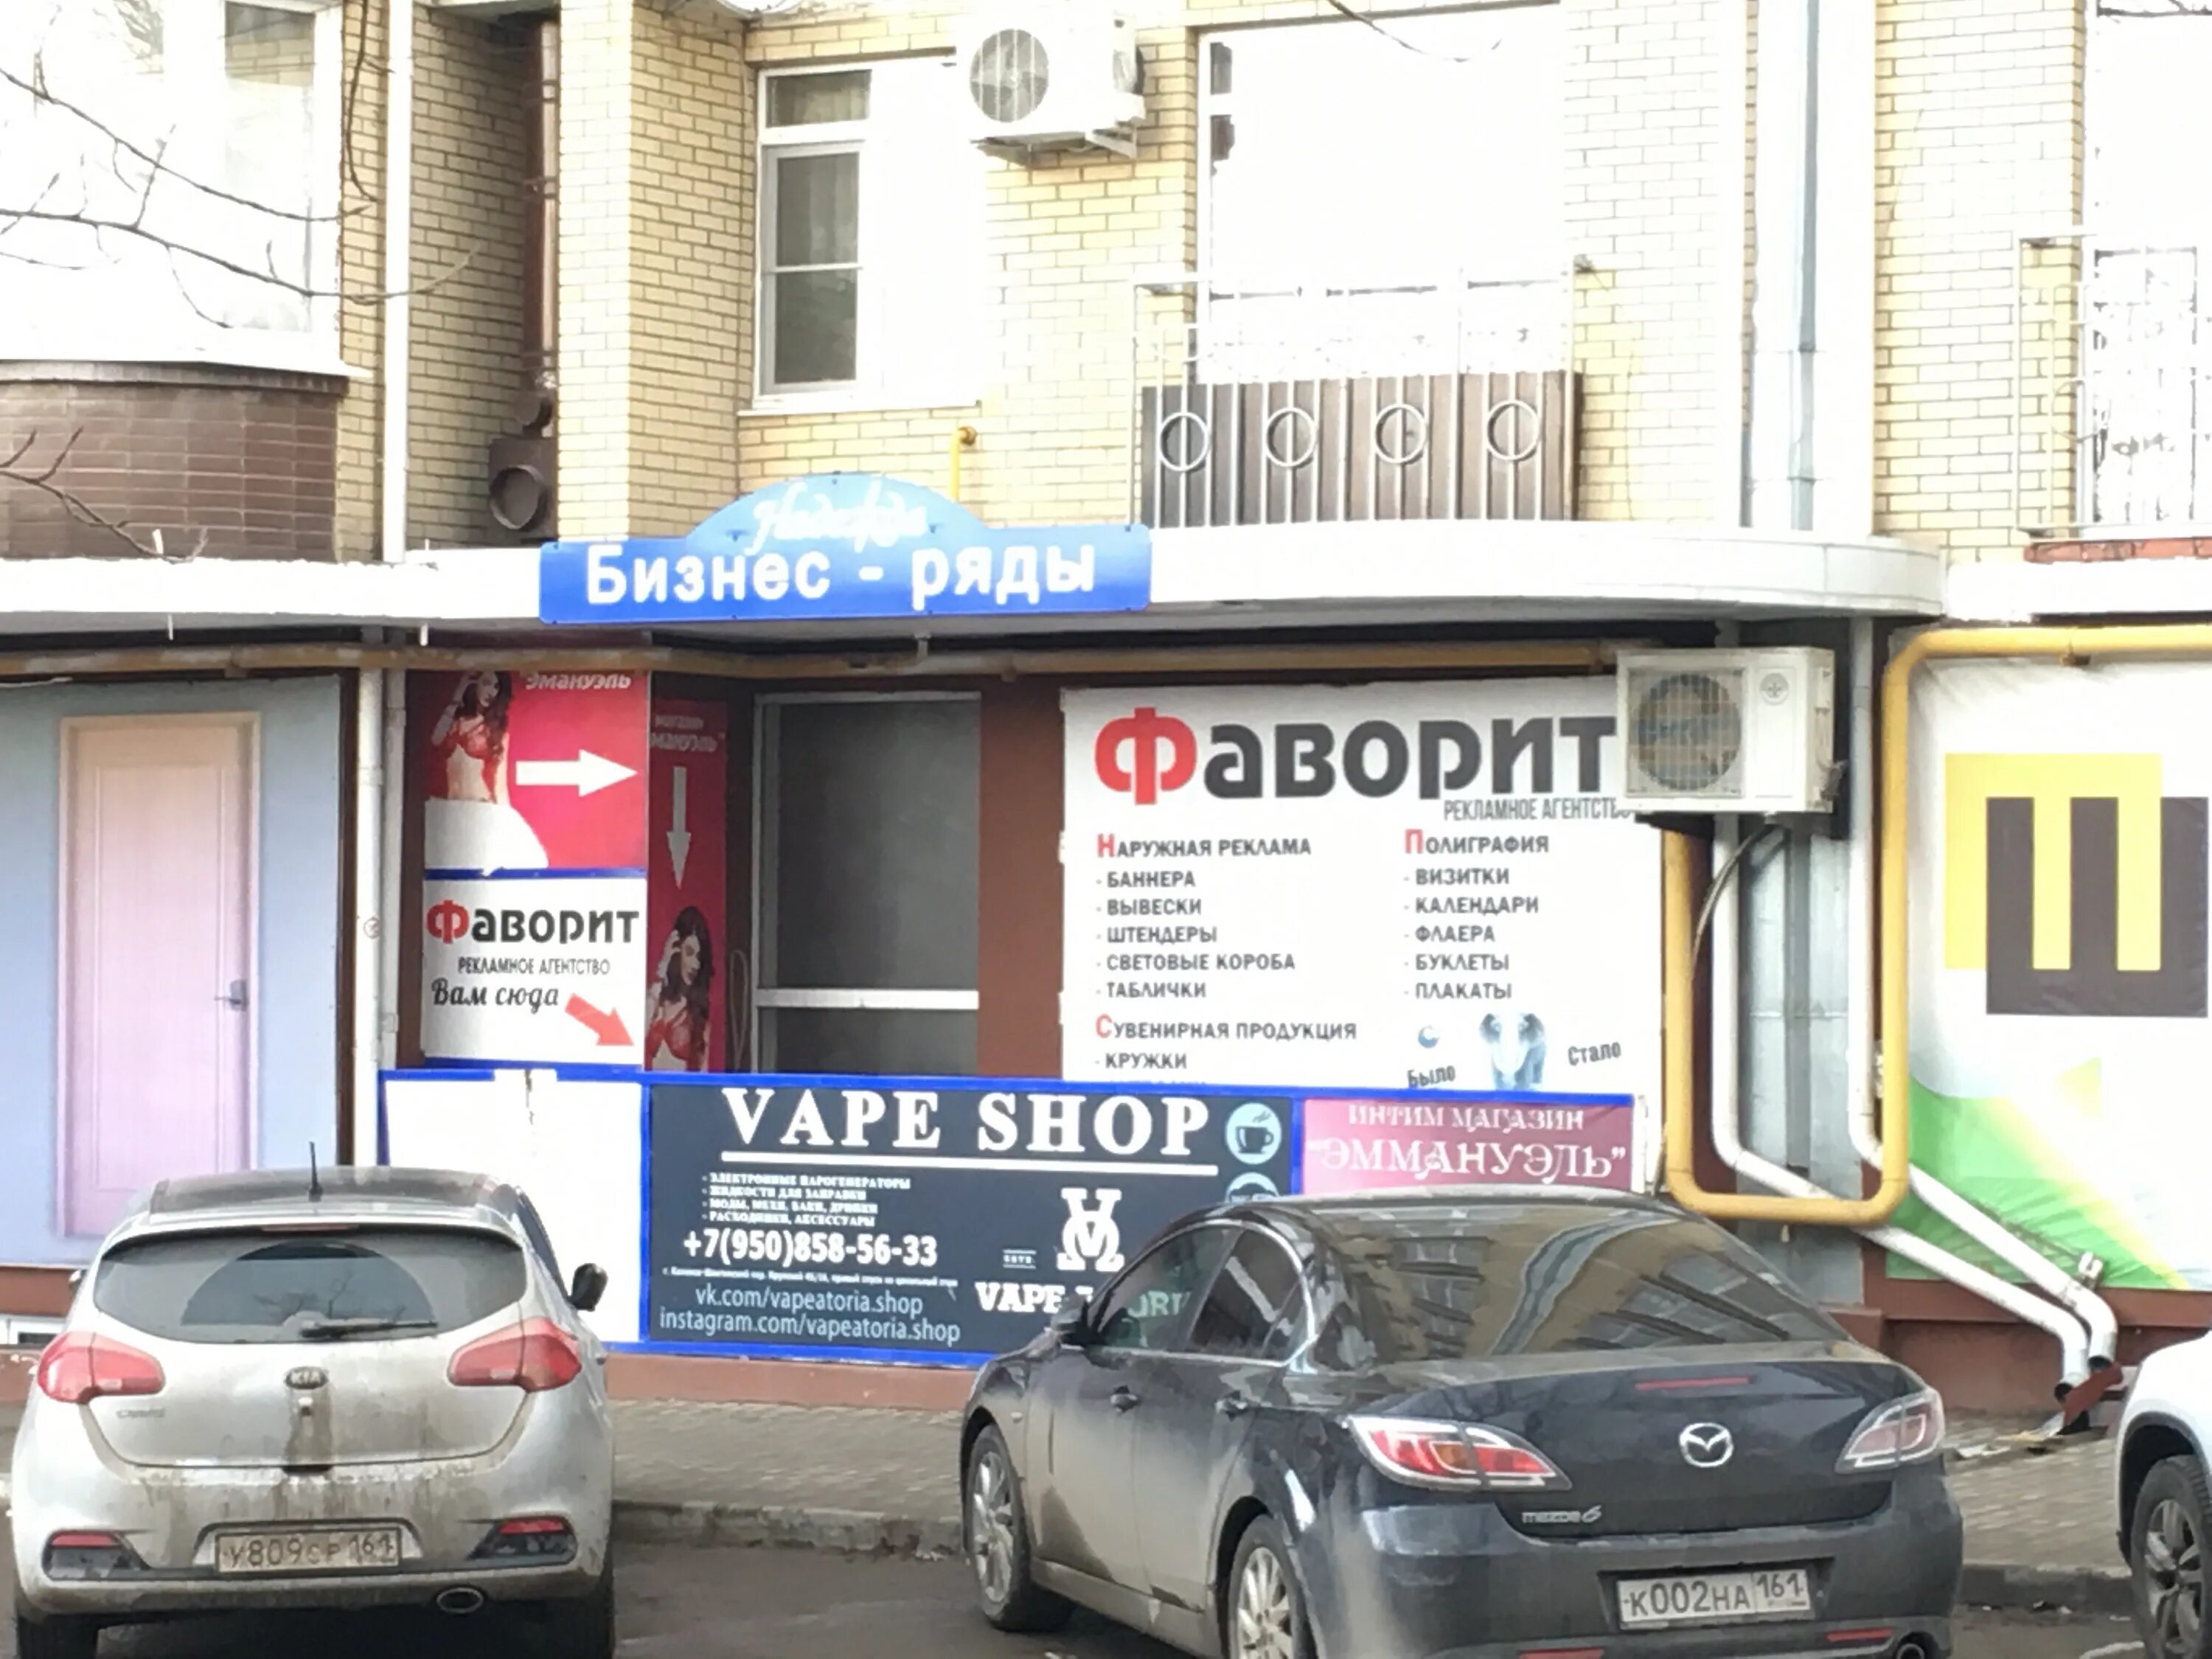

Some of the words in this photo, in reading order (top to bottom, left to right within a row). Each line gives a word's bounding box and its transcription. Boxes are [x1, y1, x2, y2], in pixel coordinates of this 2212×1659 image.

[587, 544, 831, 604] Бизнес
[912, 544, 1095, 610] ряды
[1094, 707, 1617, 805] Фаворит
[1444, 799, 1538, 821] РЕКЛАМНОЕ
[1097, 833, 1211, 858] НАРУЖНАЯ
[1218, 838, 1312, 857] РЕКЛАМА
[1405, 829, 1549, 855] ПОЛИГРАФИЯ
[1107, 871, 1196, 888] БАННЕРА
[1416, 868, 1509, 886] ВИЗИТКИ
[1107, 899, 1202, 916] ВЫВЕСКИ
[1416, 896, 1539, 915] КАЛЕНДАРИ
[426, 900, 639, 944] Фаворит
[1415, 925, 1495, 942] ФЛАЕРА
[1107, 926, 1217, 945] ШТЕНДЕРЫ
[458, 956, 534, 974] РЕКЛАМНОЕ
[539, 958, 611, 975] АГЕНТСТВО
[1107, 954, 1209, 970] СВЕТОВЫЕ
[1217, 954, 1295, 970] КОРОБА
[1416, 954, 1509, 971] БУКЛЕТЫ
[431, 977, 487, 1006] Вам
[495, 987, 559, 1014] сюда
[1107, 981, 1206, 998] ТАБЛИЧКИ
[1416, 982, 1512, 999] ПЛАКАТЫ
[1095, 1014, 1229, 1039] СУВЕНИРНАЯ
[1237, 1023, 1357, 1041] ПРОДУКЦИЯ
[1106, 1052, 1188, 1069] КРУЖКИ
[1568, 1042, 1622, 1065] Стало
[1407, 1065, 1456, 1088] Было
[721, 1088, 942, 1149] VAPE
[977, 1093, 1209, 1155] SHOP
[1349, 1103, 1444, 1127] ИНТИМ
[1452, 1107, 1584, 1134] МАГАЗИН
[684, 1227, 938, 1267] +7(950)858-56-33
[695, 1283, 923, 1320] vk.com/vapeatoria.shop
[660, 1307, 960, 1348] instagram.com/vapeatoria.shop
